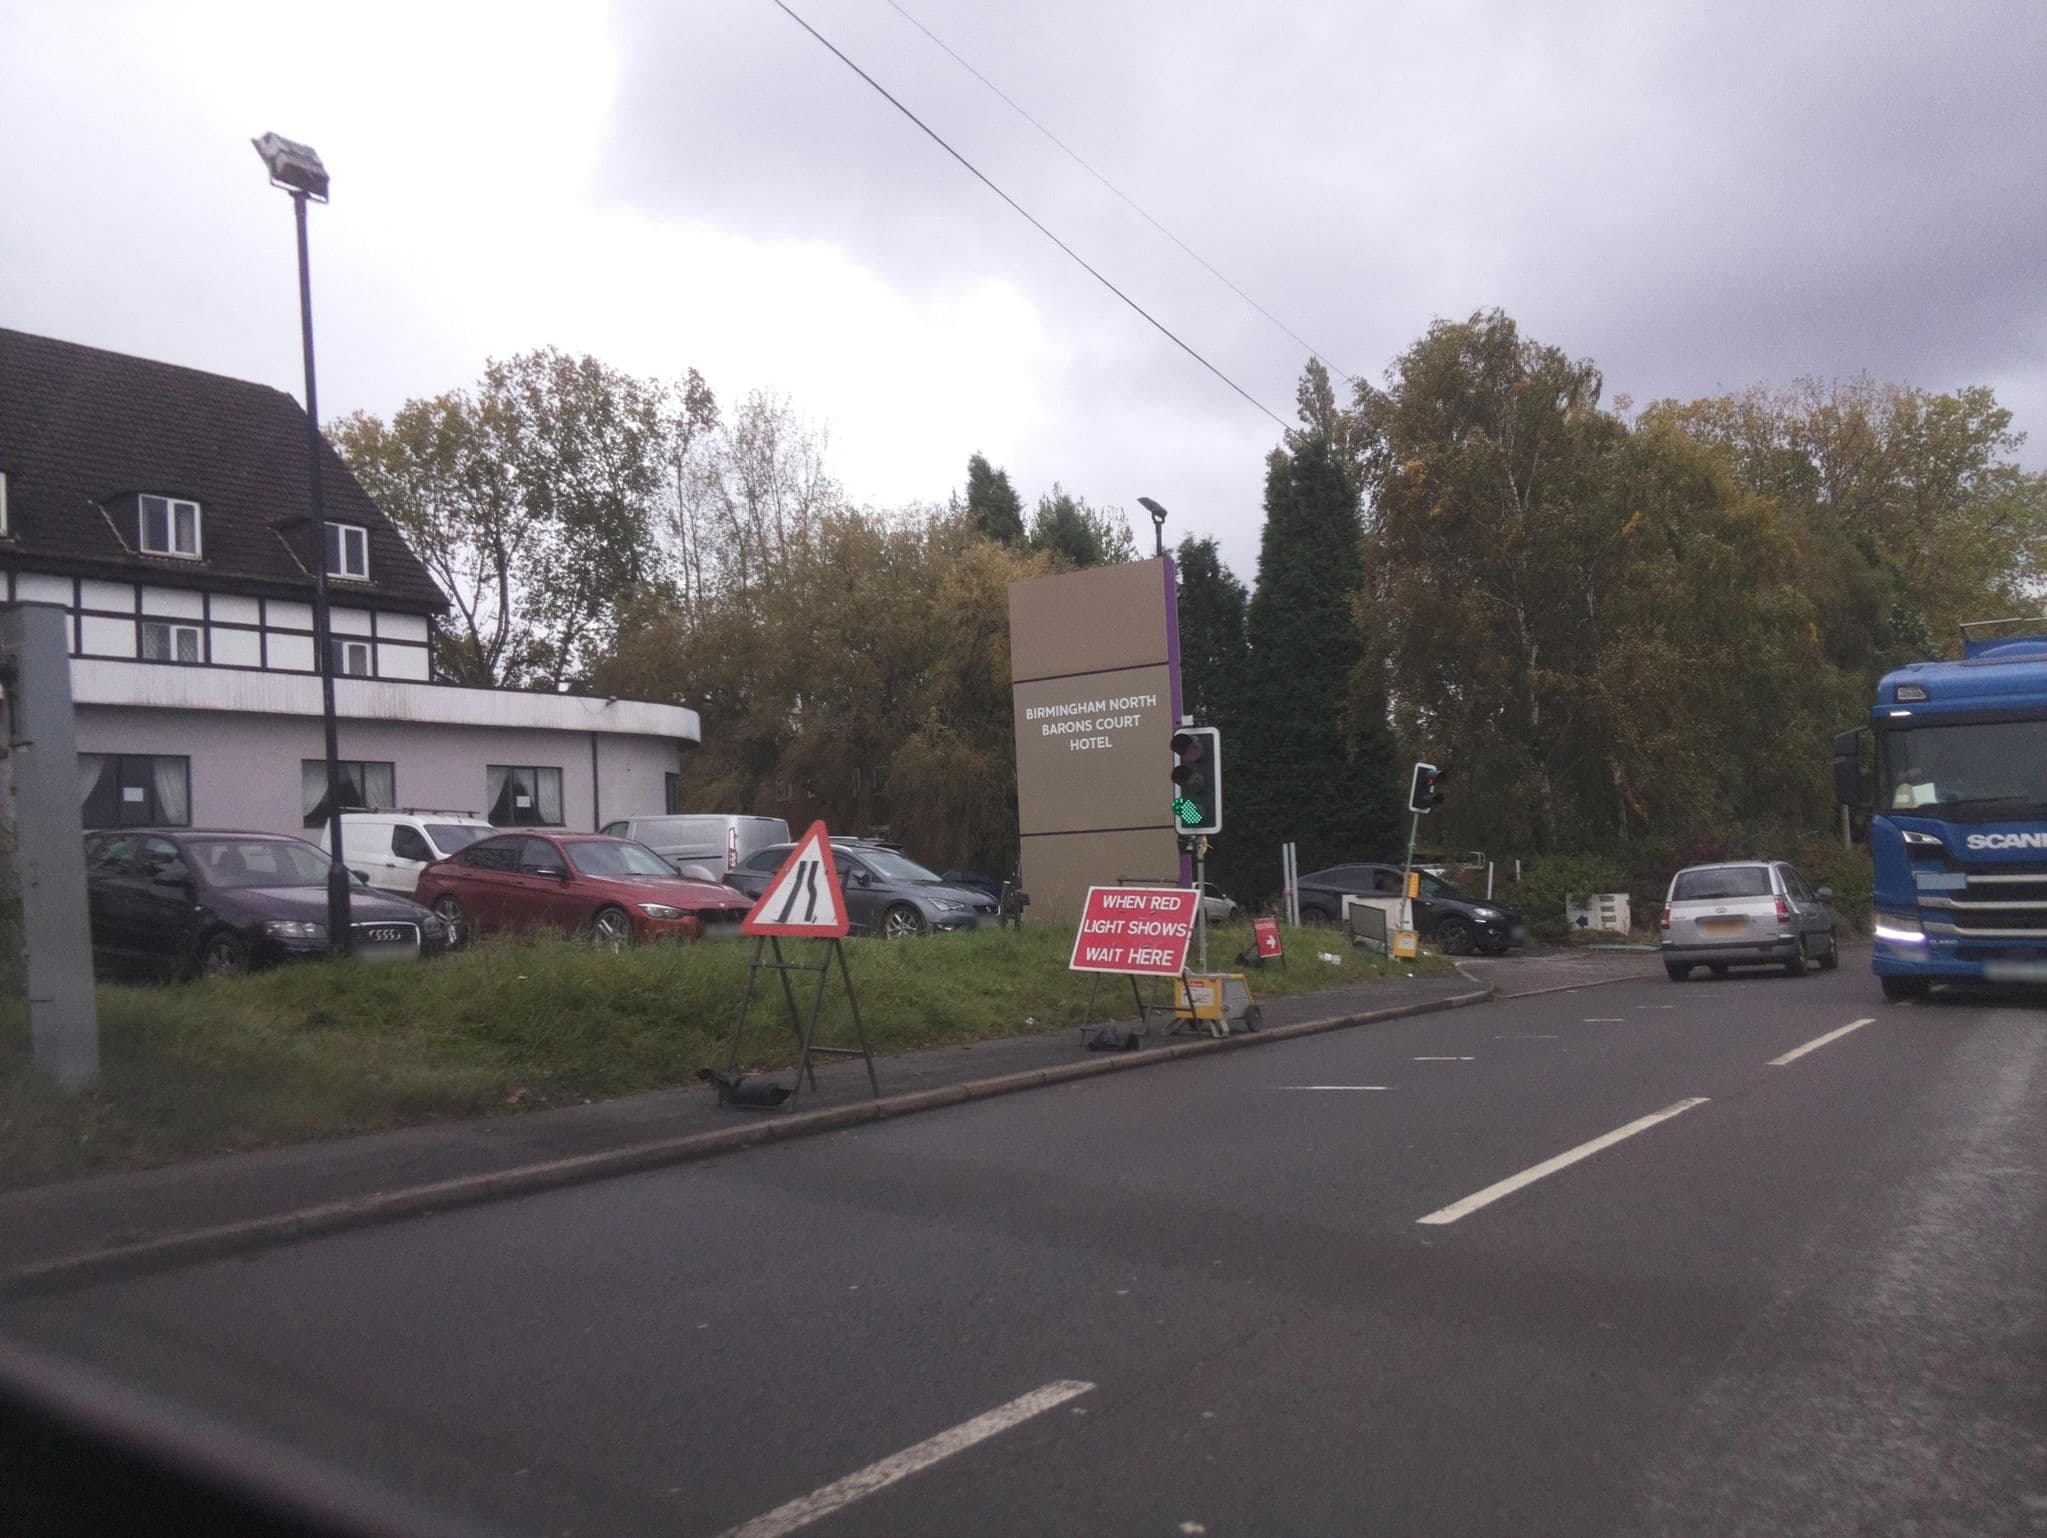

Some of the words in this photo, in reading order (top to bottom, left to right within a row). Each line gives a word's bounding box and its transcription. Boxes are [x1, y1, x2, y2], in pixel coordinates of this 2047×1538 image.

[1026, 700, 1106, 720] BIRMINGHAM
[1110, 694, 1157, 709] NORTH
[1042, 720, 1092, 736] BARONS
[1095, 715, 1141, 730] COURT
[1070, 736, 1113, 751] HOTEL
[1103, 895, 1147, 910] WHEN
[1151, 896, 1181, 911] RED
[1084, 919, 1126, 934] LIGHT
[1127, 921, 1188, 937] SHOWS
[1086, 947, 1124, 963] WAIT
[1128, 949, 1175, 966] HERE
